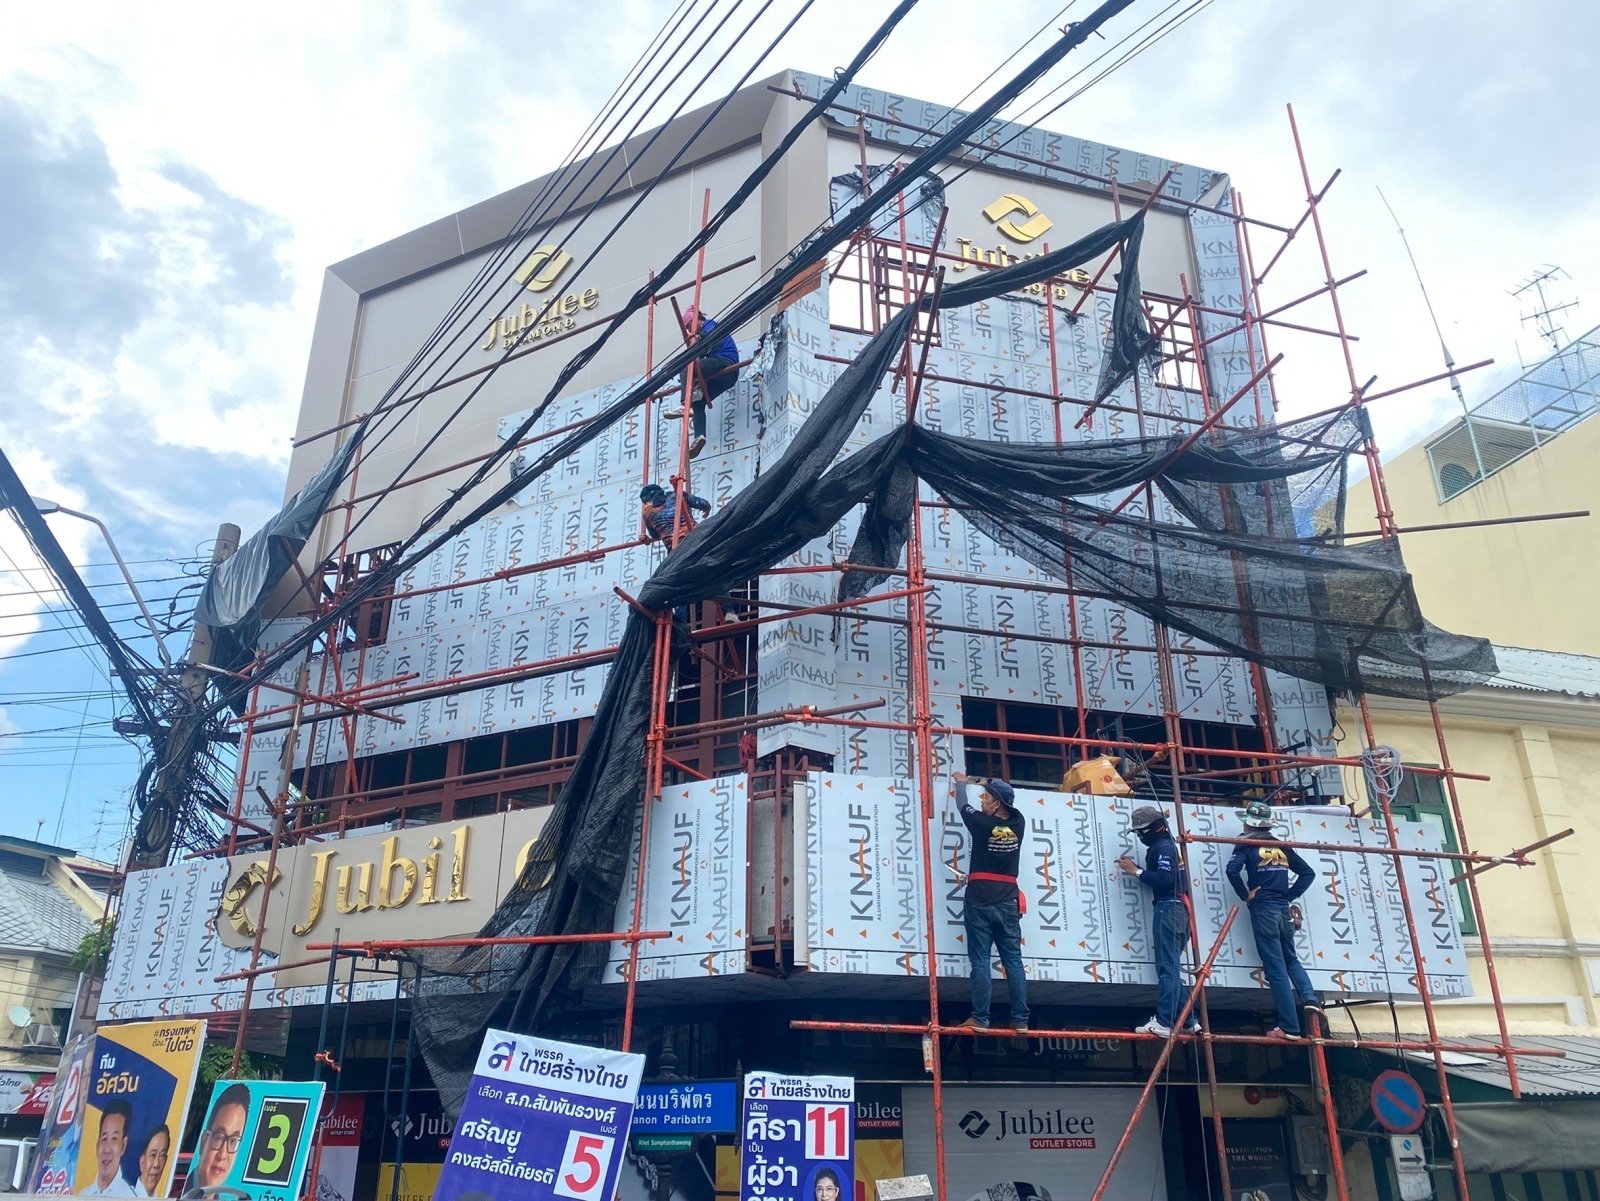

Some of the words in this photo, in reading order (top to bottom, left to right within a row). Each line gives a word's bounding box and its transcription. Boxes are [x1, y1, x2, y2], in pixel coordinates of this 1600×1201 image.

[482, 287, 600, 351] Jubilee
[670, 812, 694, 927] KNAUF
[849, 803, 874, 921] KNAUF
[1031, 818, 1061, 932] KNAUF
[145, 888, 172, 978] KNAUF
[100, 1053, 115, 1069] ทีม
[519, 1052, 628, 1089] ไทยสร้างไทย
[534, 1048, 563, 1061] พรรค
[96, 1072, 139, 1095] อัศวิน
[635, 1086, 712, 1110] นนบริพัตร
[771, 1082, 851, 1099] ไทยสร้างไทย
[780, 1078, 802, 1086] พรรค
[478, 1085, 502, 1099] เลือก
[504, 1092, 617, 1124] ส.ก.สัมพันธวงศ์
[633, 1116, 657, 1124] anon
[663, 1115, 712, 1124] Paribatra
[750, 1102, 768, 1111] เลือก
[460, 1118, 521, 1153] ศรัณยู
[746, 1112, 801, 1141] ศิธา
[807, 1106, 846, 1157] 11
[996, 1109, 1095, 1141] Jubilee
[257, 1114, 291, 1174] 3
[749, 1141, 763, 1153] เป็น
[1032, 1140, 1065, 1148] OUTLET
[1067, 1140, 1094, 1148] STORE
[451, 1151, 555, 1185] คงสวัสดิ์เกียรติ
[564, 1136, 604, 1193] 5
[747, 1155, 798, 1195] ผู้ว่า
